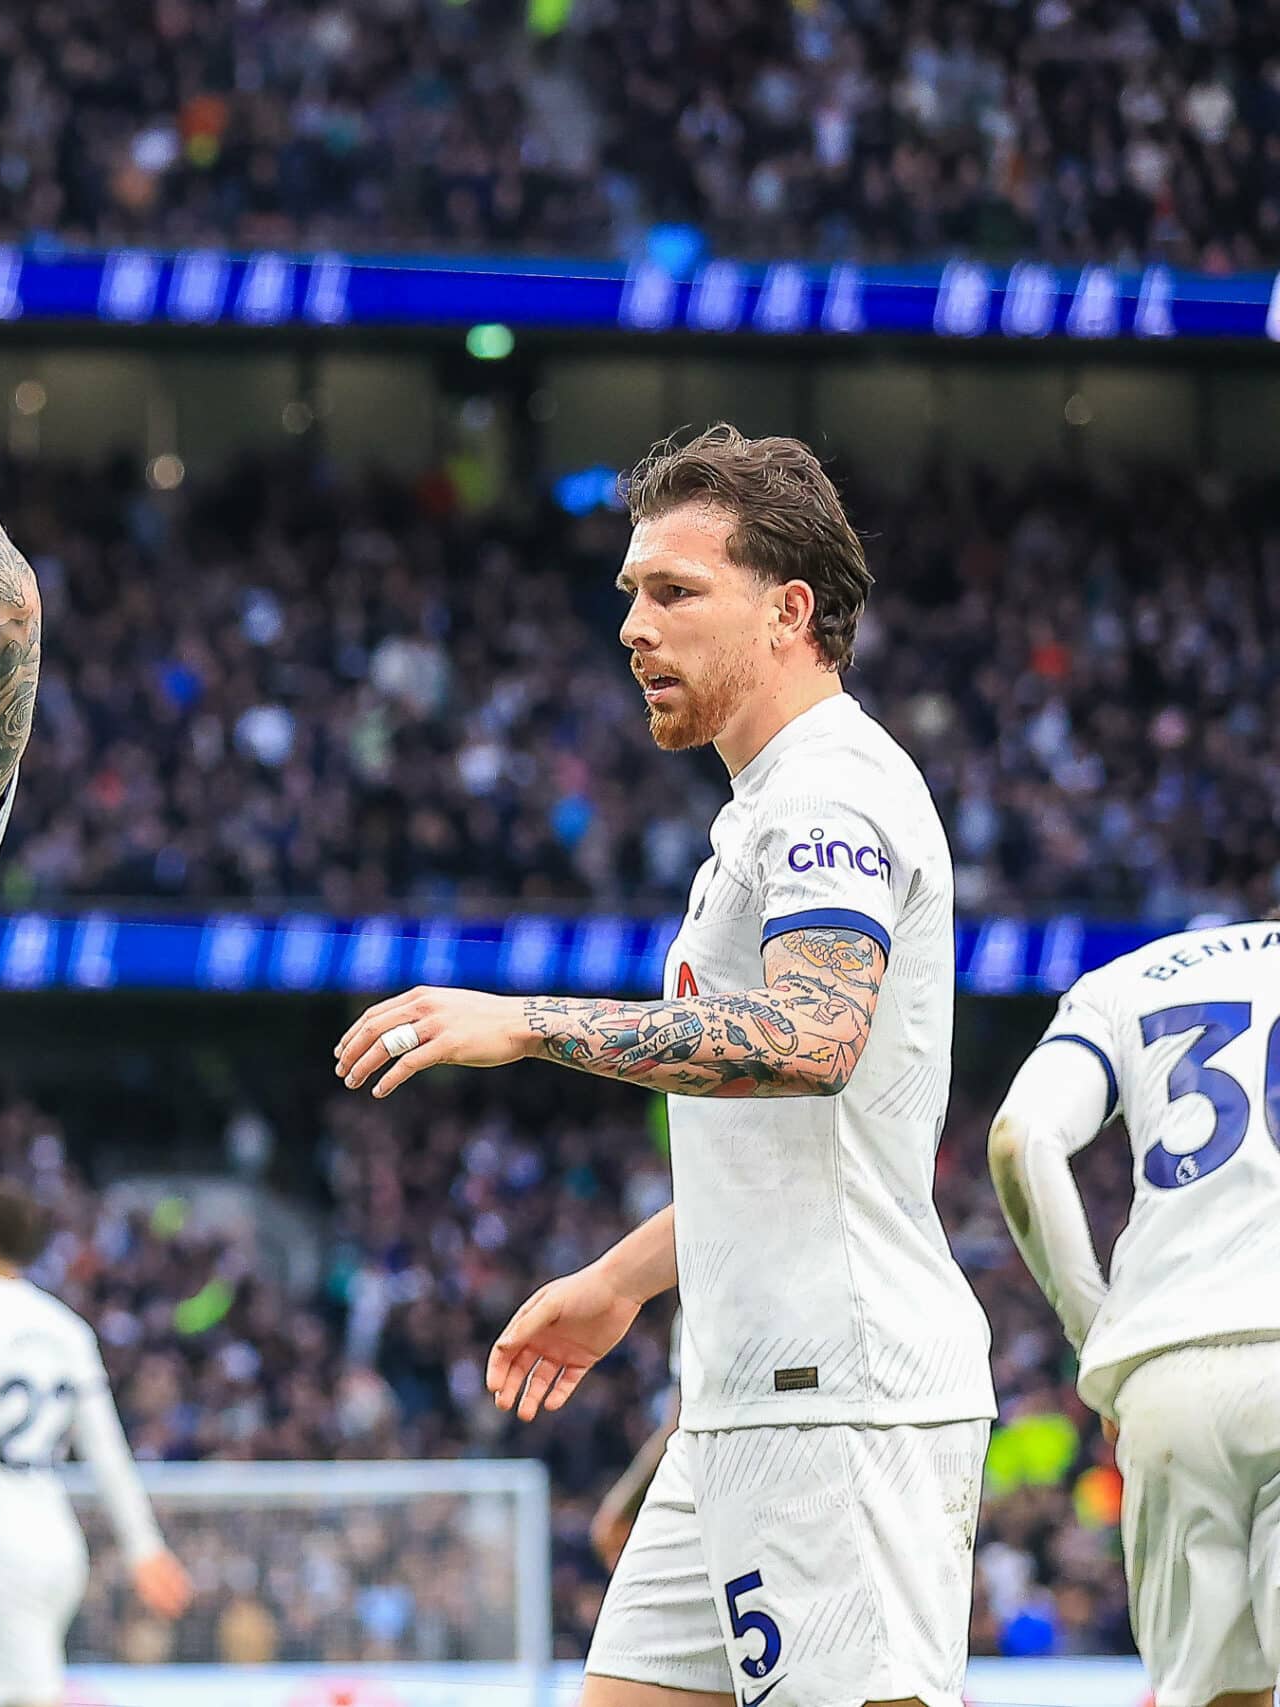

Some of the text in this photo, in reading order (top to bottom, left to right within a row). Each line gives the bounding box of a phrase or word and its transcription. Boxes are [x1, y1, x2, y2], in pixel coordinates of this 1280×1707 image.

[788, 828, 891, 888] cinch
[659, 1028, 671, 1044] OF
[673, 1017, 701, 1039] LIFE
[1139, 1002, 1280, 1189] 3
[724, 1569, 782, 1679] 5
